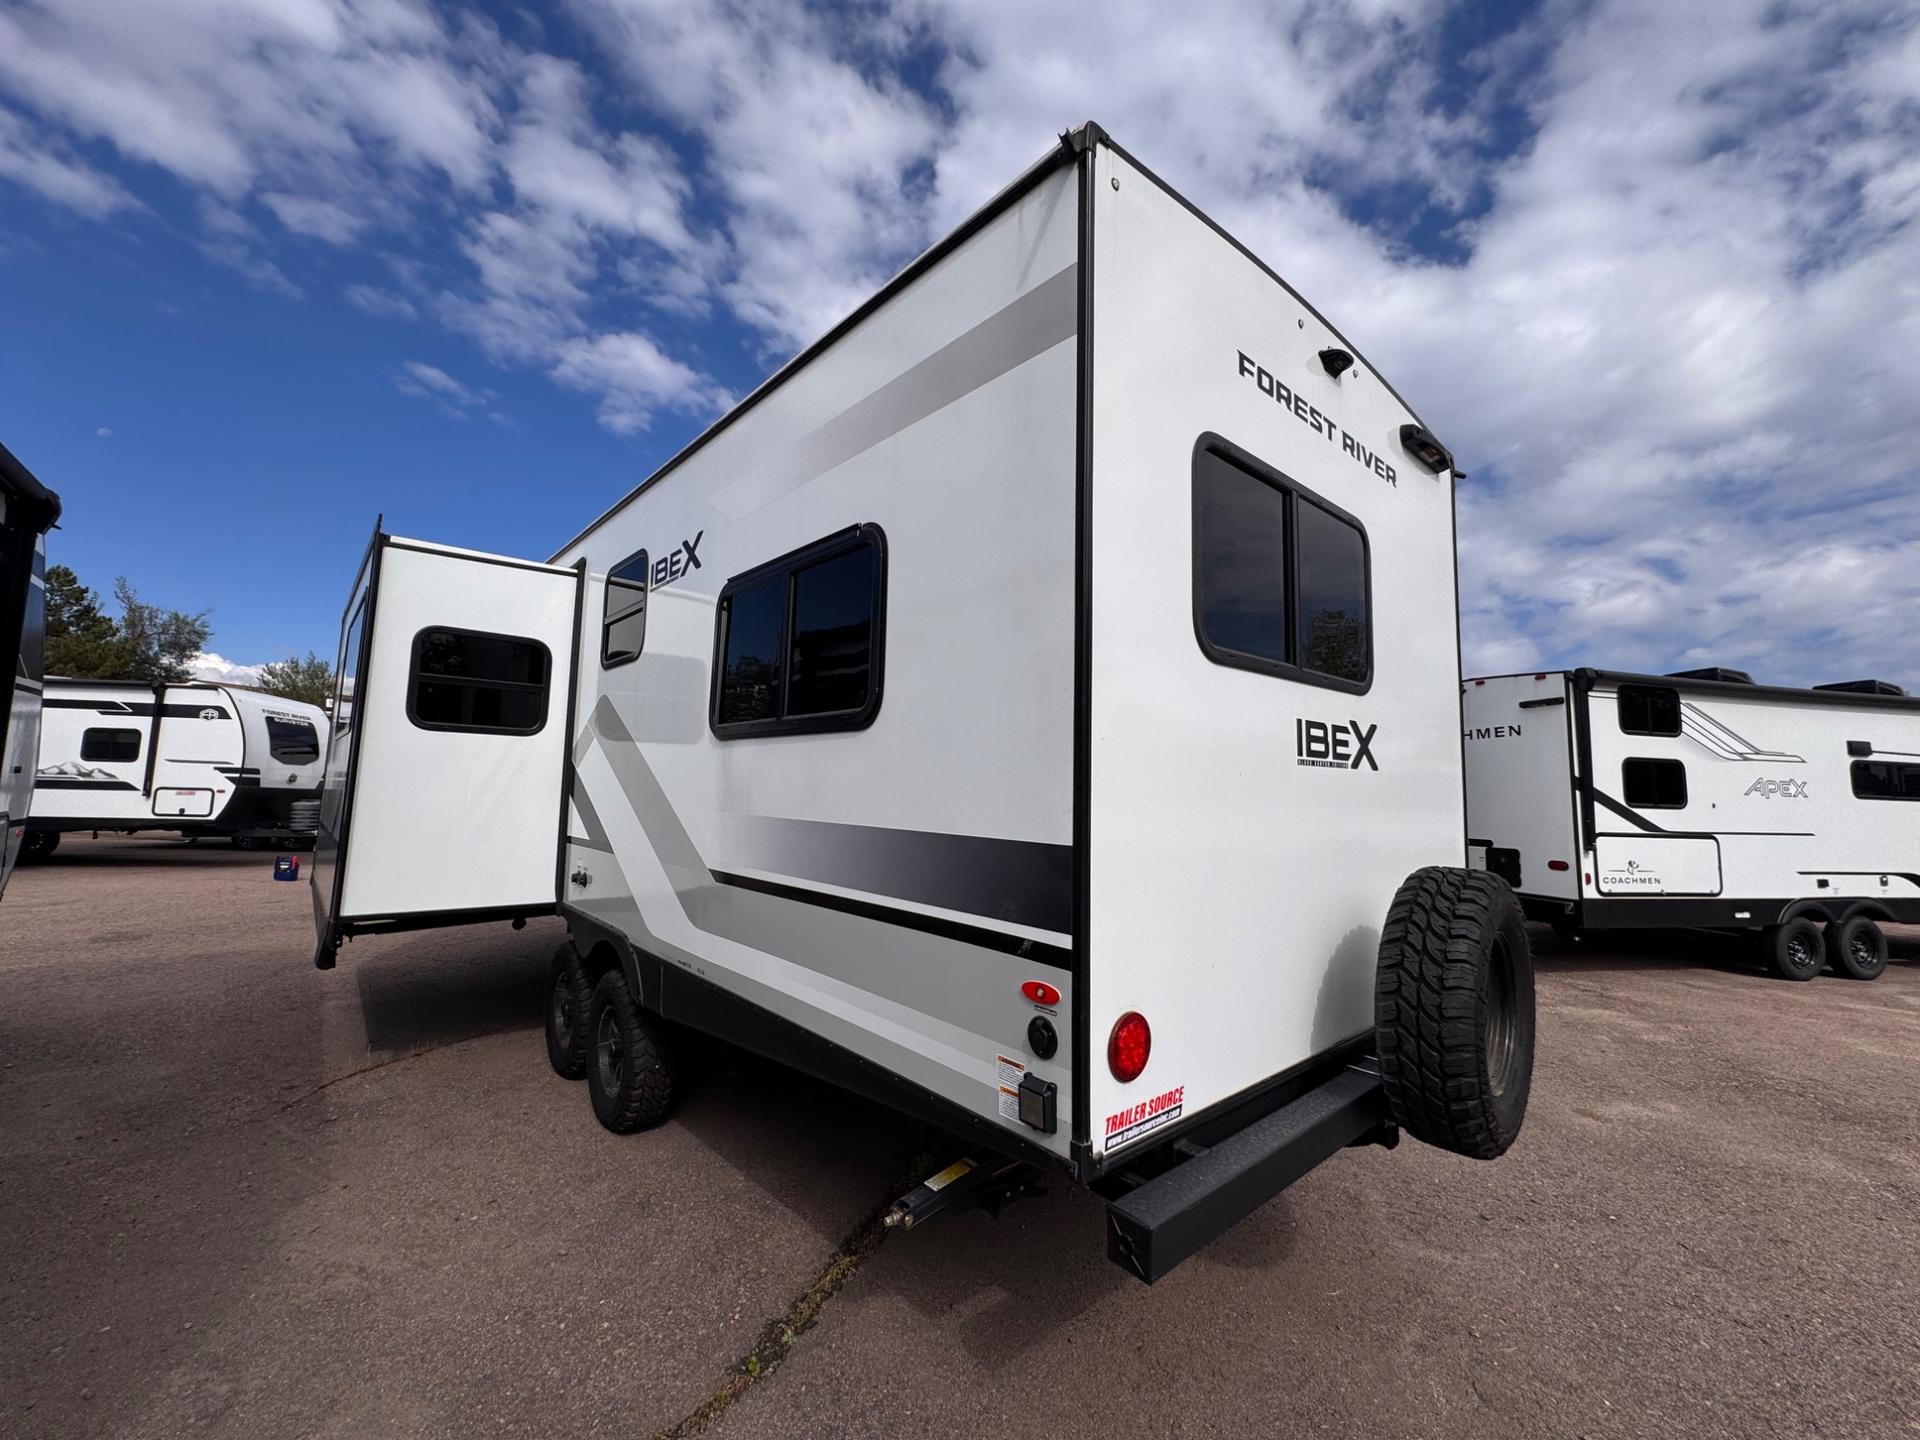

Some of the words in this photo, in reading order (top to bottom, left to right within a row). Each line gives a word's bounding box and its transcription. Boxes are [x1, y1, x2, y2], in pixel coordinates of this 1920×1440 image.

[1237, 349, 1337, 442] FOREST
[1341, 429, 1397, 488] RIVER
[650, 529, 704, 588] IBEX
[1296, 717, 1379, 771] IBEX
[1743, 777, 1809, 799] APEX
[1602, 876, 1661, 885] COACHMEN
[1105, 1102, 1147, 1136] TRAILER
[1147, 1085, 1184, 1117] SOURCE
